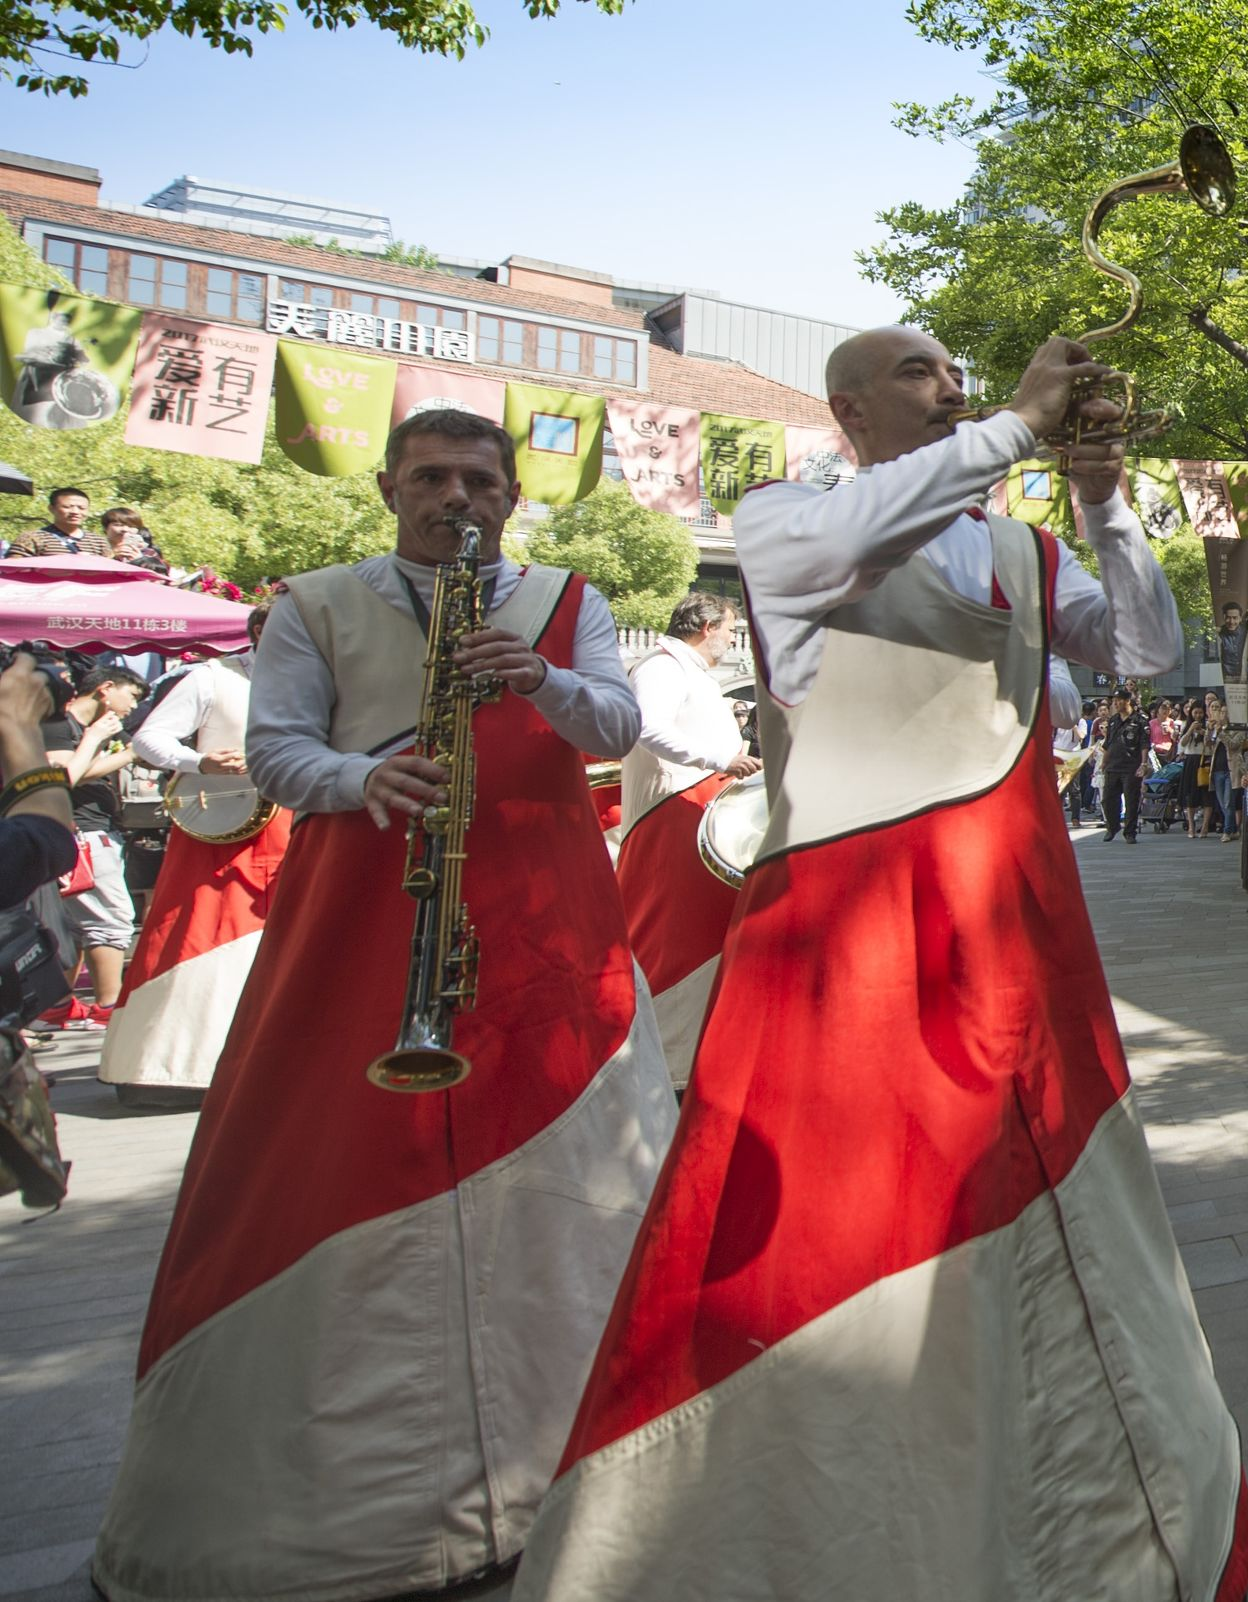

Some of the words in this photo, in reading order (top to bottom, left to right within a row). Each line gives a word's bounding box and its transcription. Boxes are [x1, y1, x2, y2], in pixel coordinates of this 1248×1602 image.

[304, 363, 370, 391] LOVE
[287, 424, 369, 448] ARTS
[631, 418, 680, 439] LOVE
[649, 446, 662, 459] &
[631, 466, 685, 487] ARTS
[47, 616, 188, 633] 武汉天地11栋3楼
